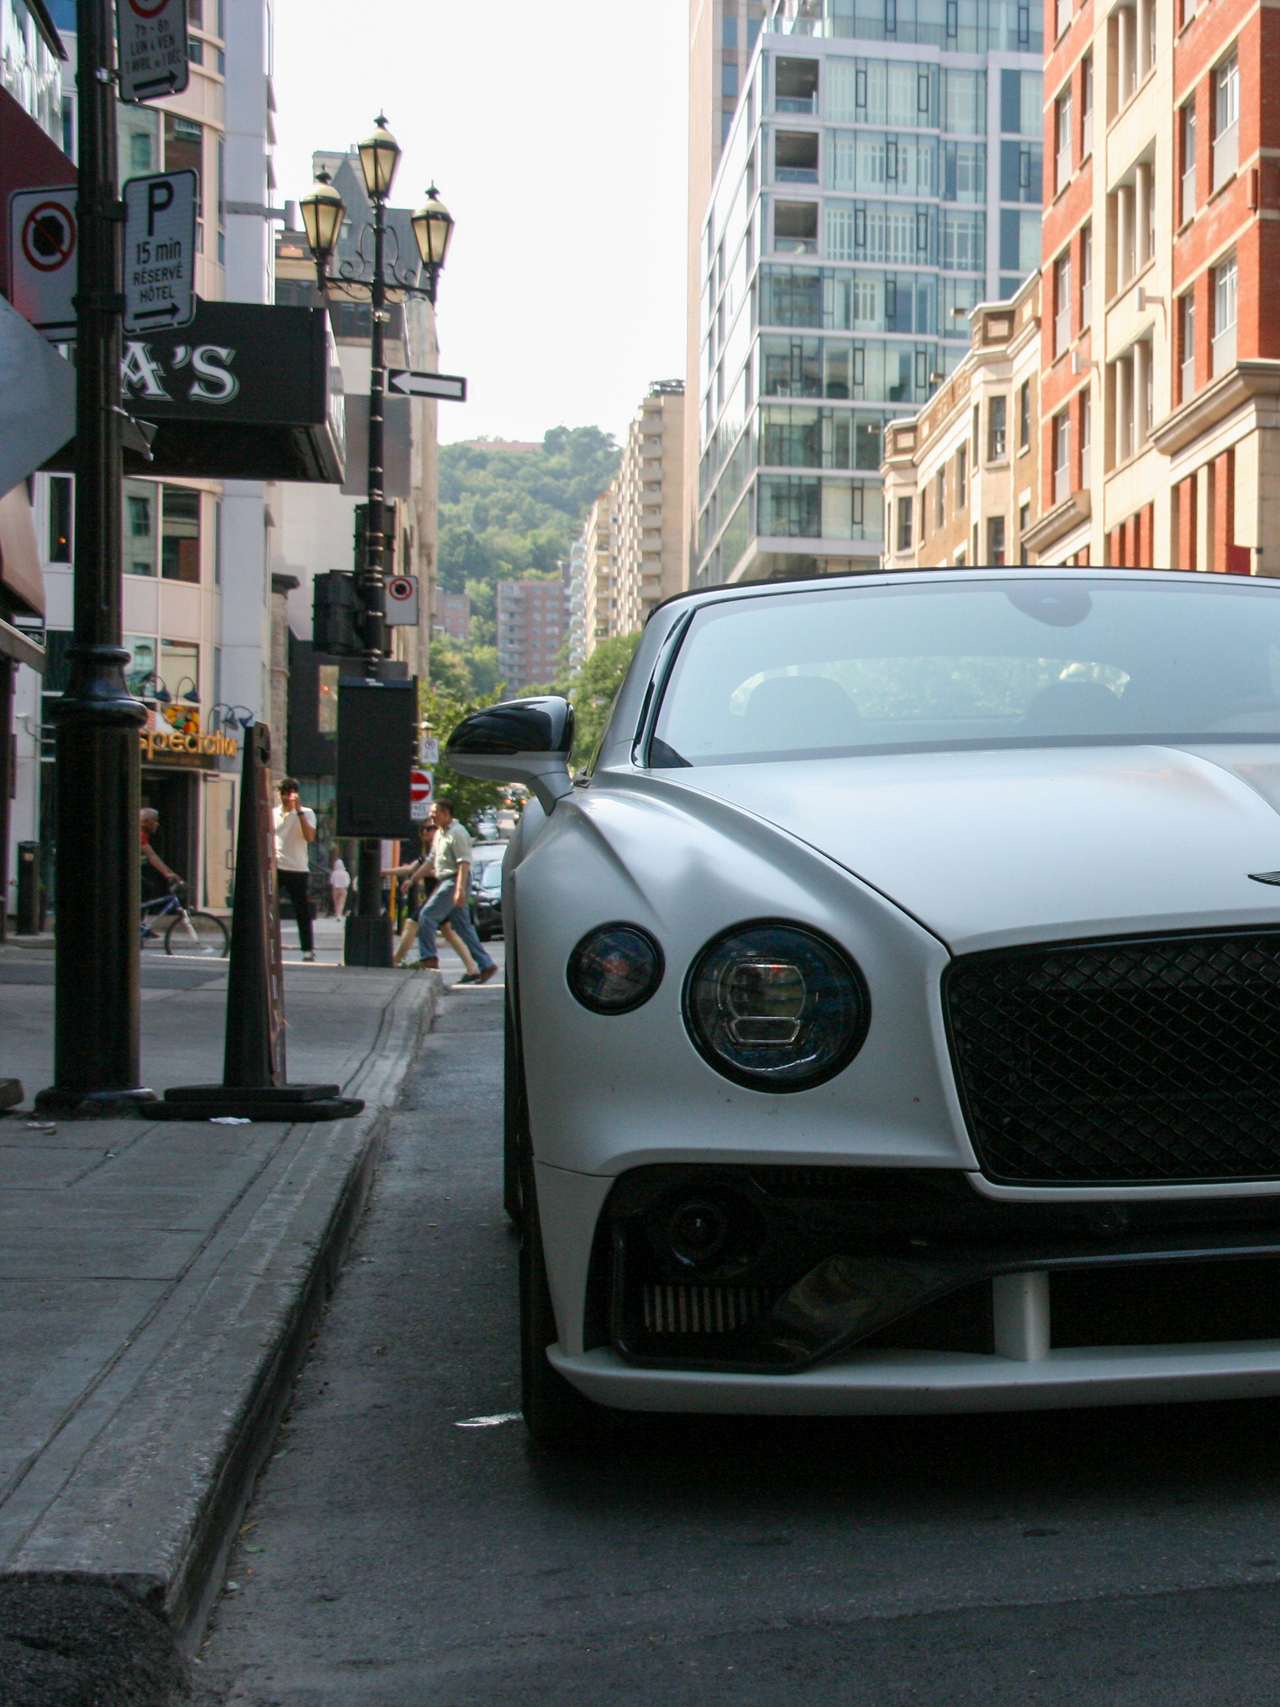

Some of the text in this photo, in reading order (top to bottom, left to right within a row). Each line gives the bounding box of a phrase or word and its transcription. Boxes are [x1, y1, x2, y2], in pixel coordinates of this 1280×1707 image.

[130, 40, 148, 56] LUN
[157, 33, 175, 48] VEN
[148, 181, 174, 236] P
[136, 237, 182, 264] 15 min
[133, 261, 183, 286] RÉSERVÉ
[140, 285, 175, 303] HÔTEL
